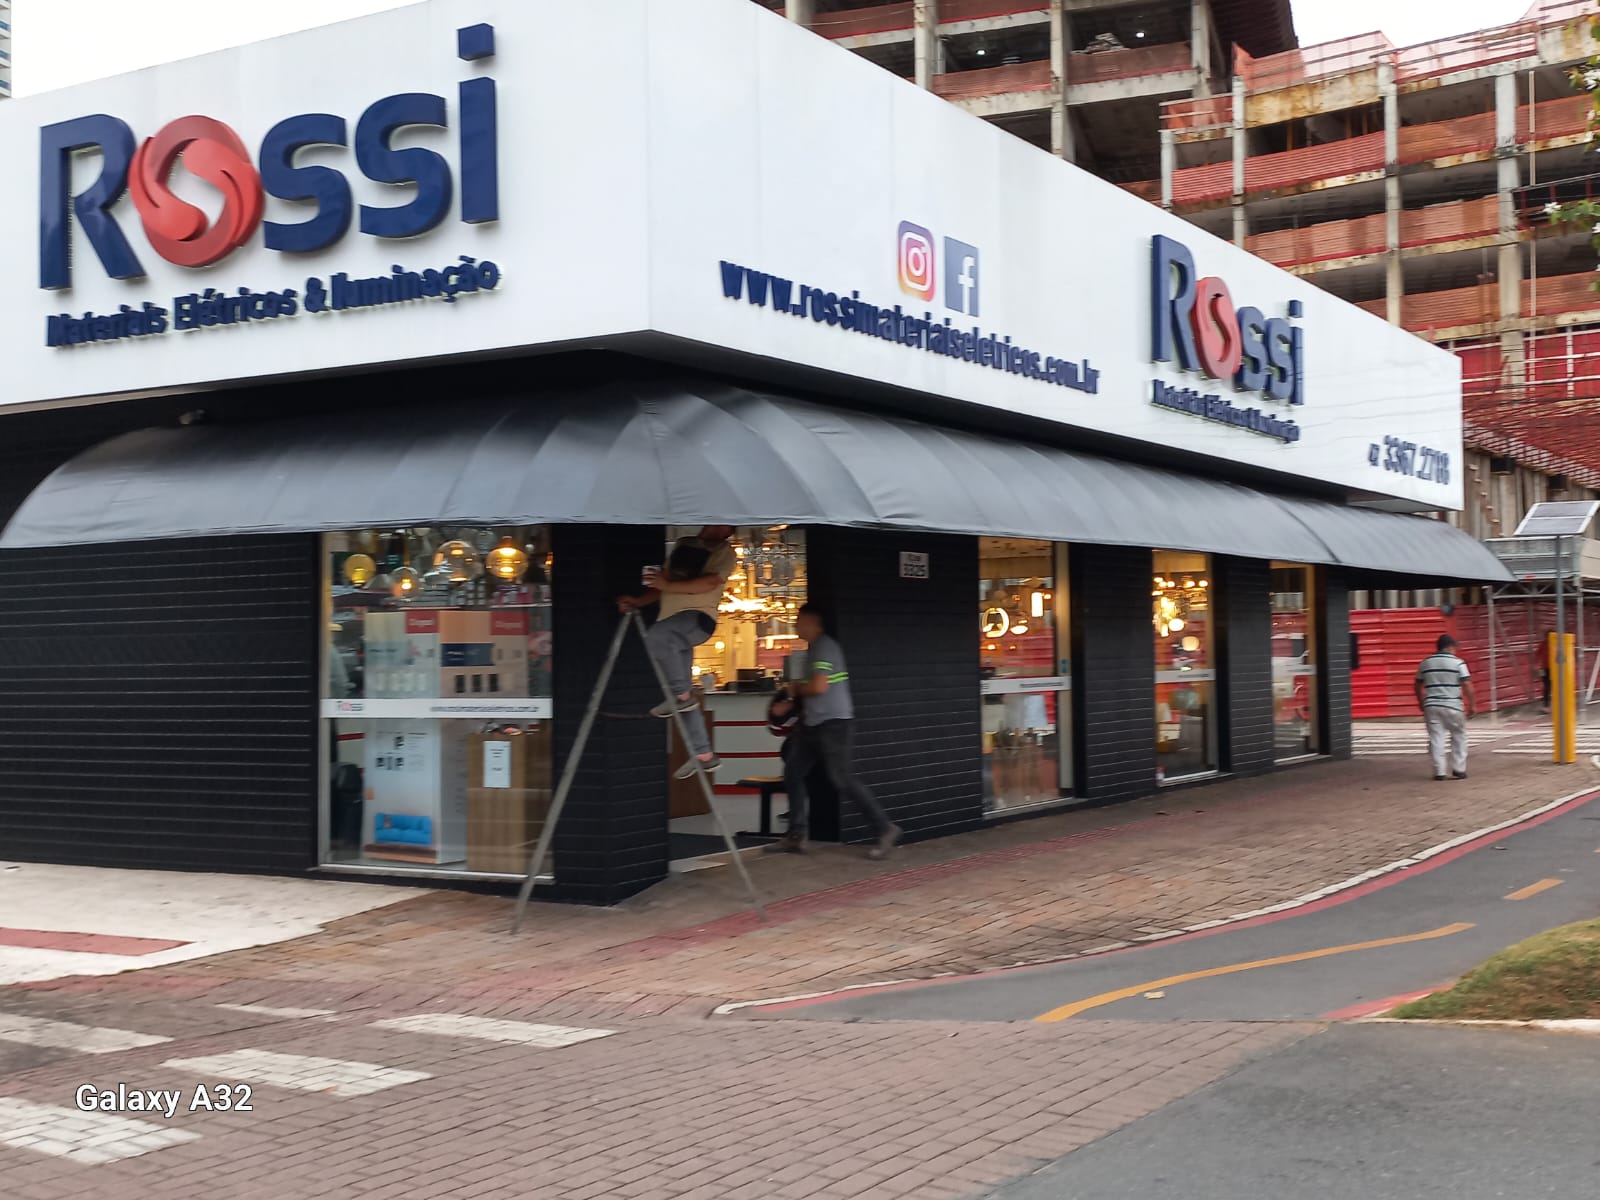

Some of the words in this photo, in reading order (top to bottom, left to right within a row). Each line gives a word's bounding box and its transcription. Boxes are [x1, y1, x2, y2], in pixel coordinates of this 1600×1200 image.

[40, 23, 499, 290] Rossi
[173, 286, 297, 331] Elétricos
[304, 277, 329, 313] &
[330, 254, 500, 311] Iluminação
[719, 260, 1100, 394] www.rossimateriaiseletricos.com.br
[1151, 234, 1304, 406] Rossi
